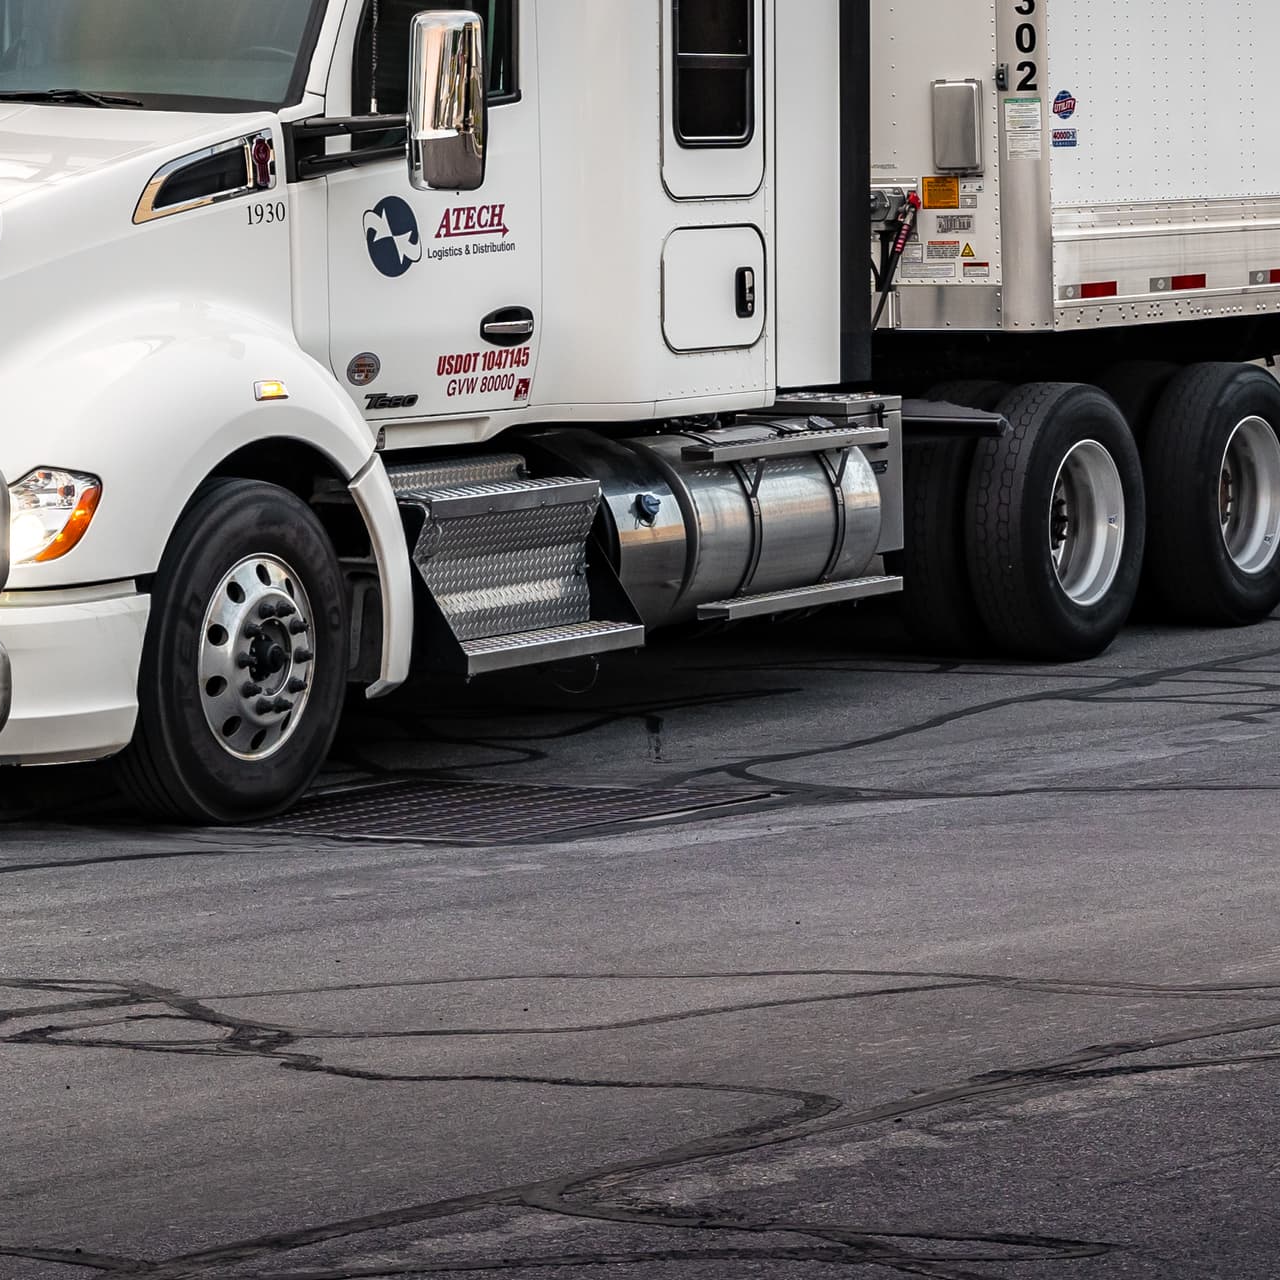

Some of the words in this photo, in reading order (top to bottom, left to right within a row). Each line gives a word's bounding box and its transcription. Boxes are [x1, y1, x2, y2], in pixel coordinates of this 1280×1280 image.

[1054, 99, 1075, 113] UTILITY
[246, 201, 286, 225] 1930
[434, 203, 505, 238] ATECH
[427, 246, 463, 261] Logistics
[464, 244, 471, 256] &
[472, 241, 516, 255] Distribution
[437, 352, 480, 376] USDOT
[481, 346, 530, 372] 1047145
[446, 376, 478, 397] GVW
[479, 372, 515, 393] 80000
[364, 392, 419, 410] T680
